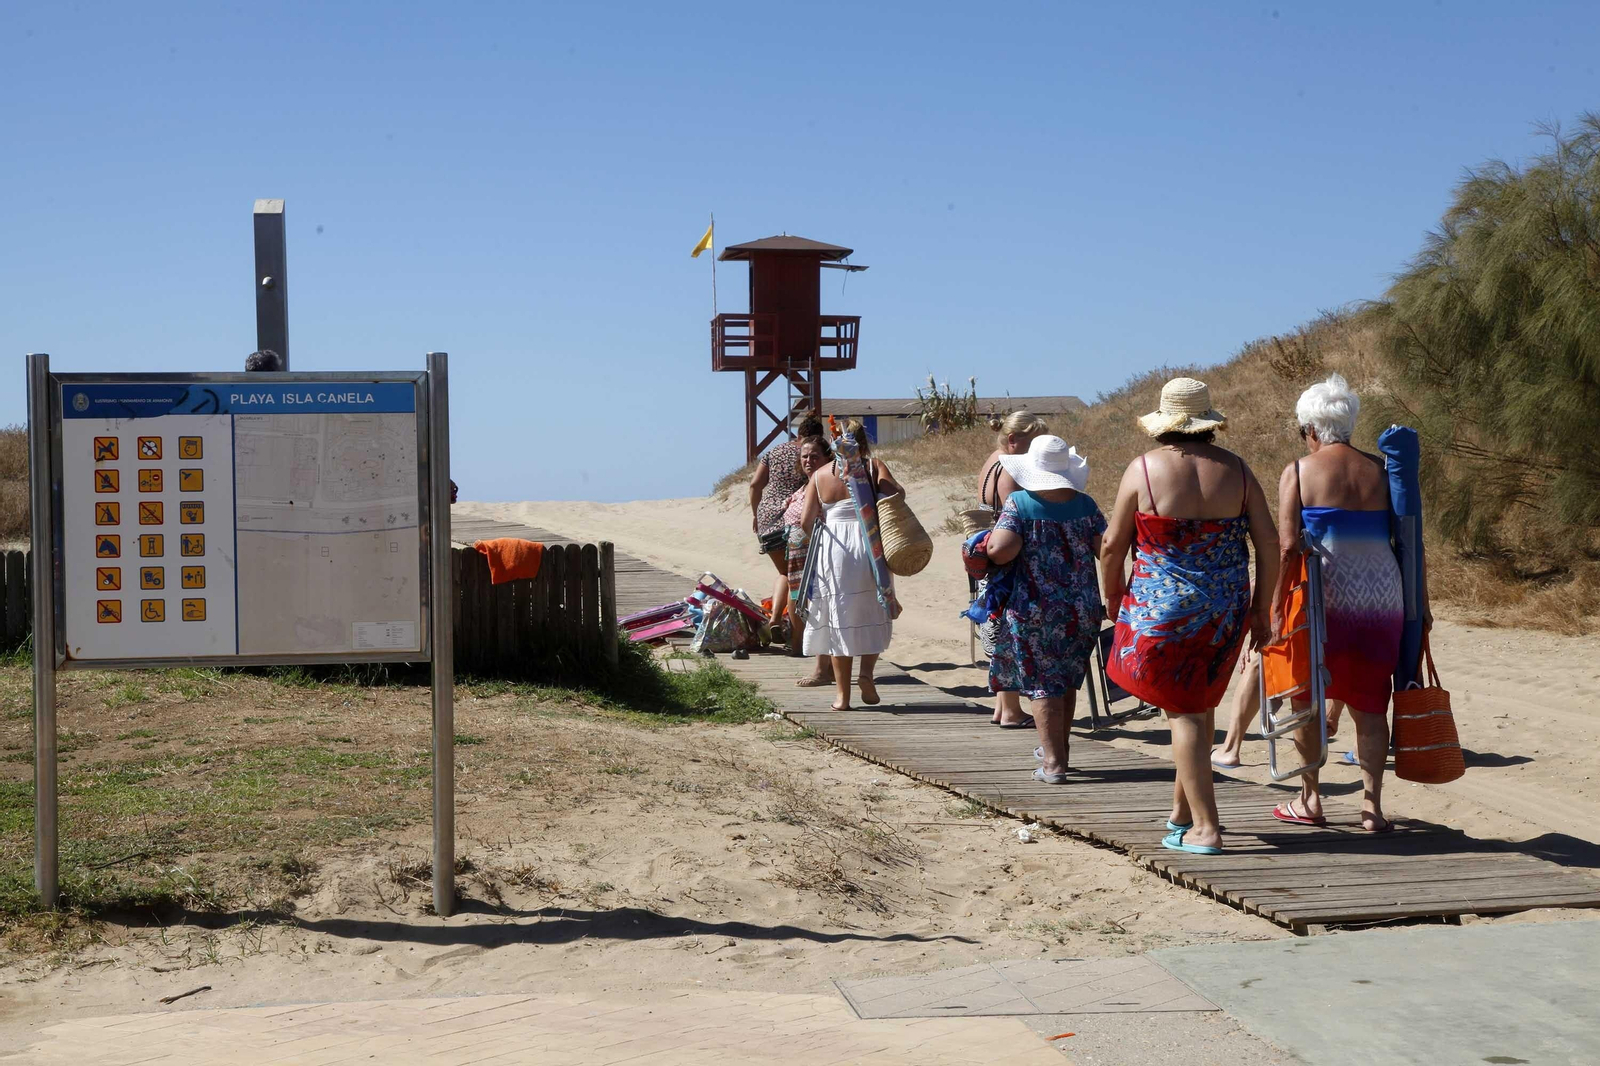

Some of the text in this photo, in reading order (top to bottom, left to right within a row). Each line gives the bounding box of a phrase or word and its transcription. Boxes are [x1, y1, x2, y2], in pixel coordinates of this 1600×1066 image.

[230, 392, 375, 405] PLAYA ISLA CANELA
